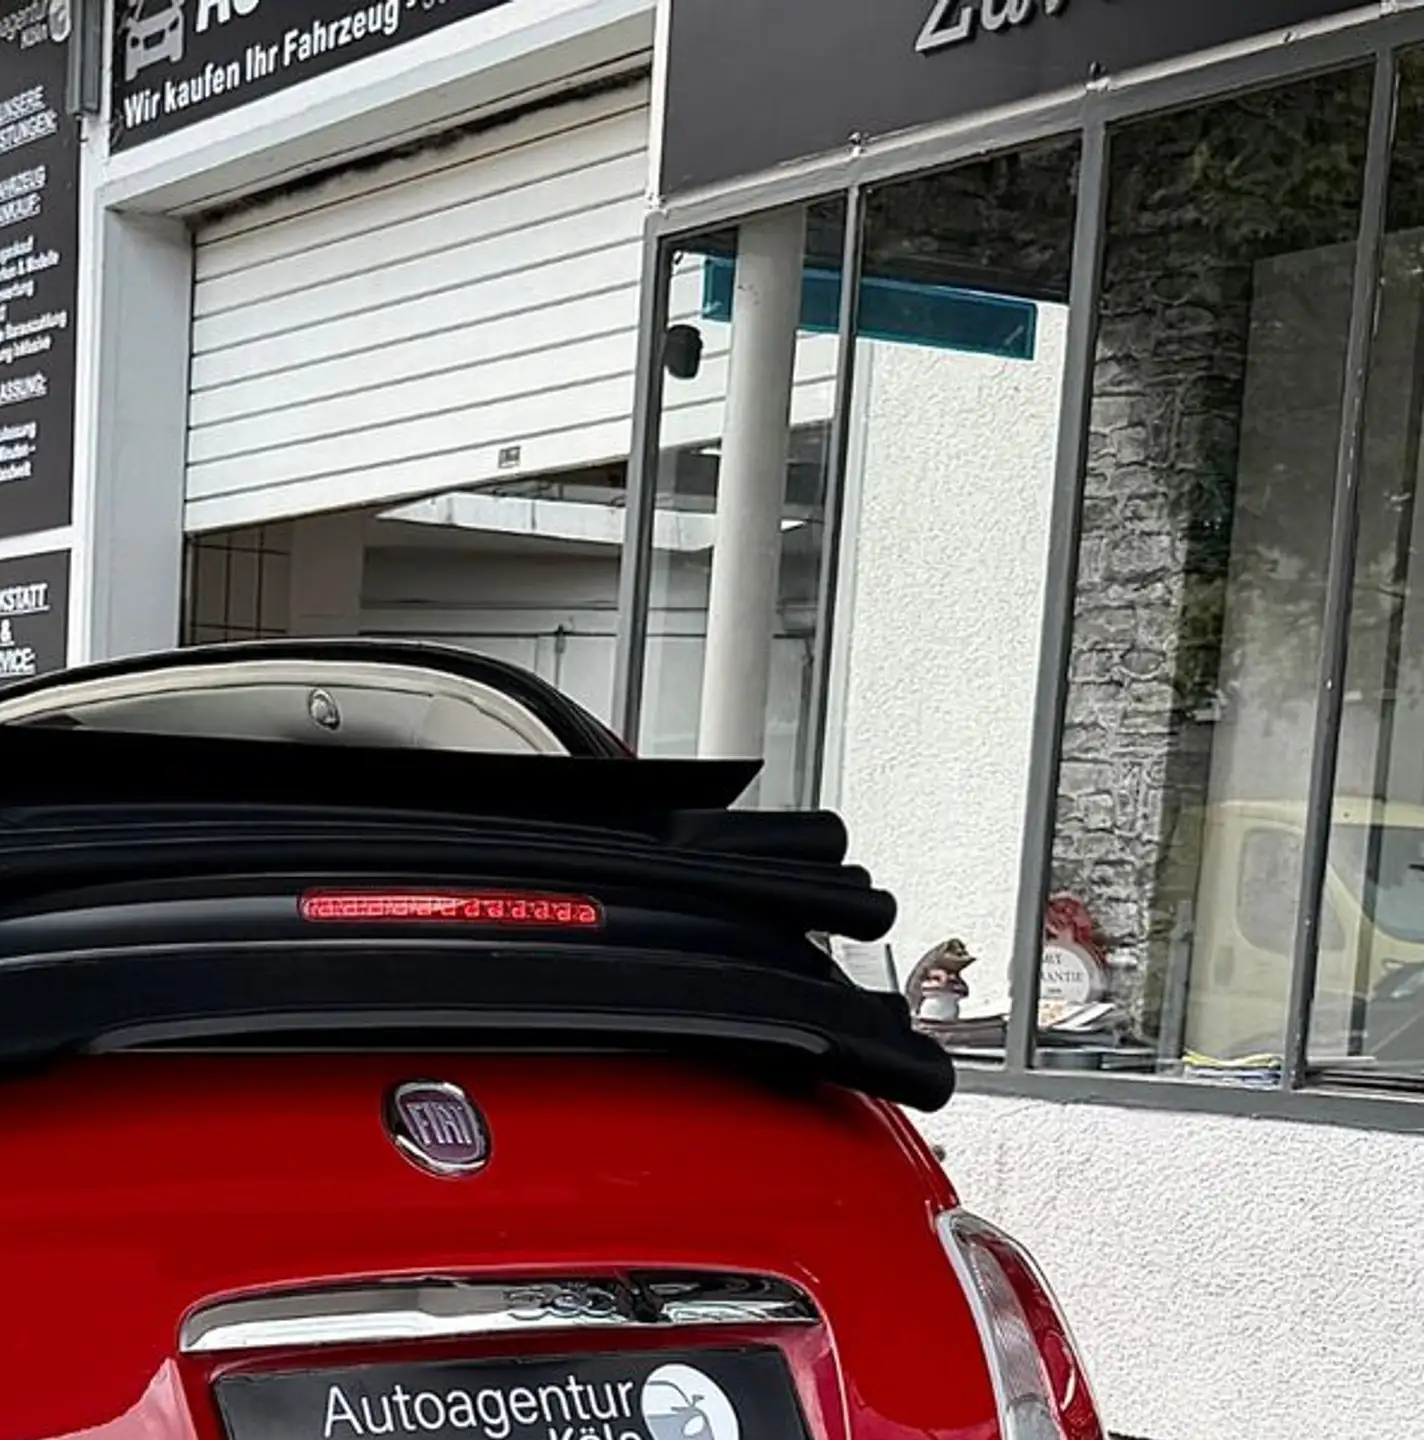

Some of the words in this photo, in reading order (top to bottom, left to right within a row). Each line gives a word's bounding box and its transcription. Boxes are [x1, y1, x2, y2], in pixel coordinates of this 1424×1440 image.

[123, 93, 160, 129] Wir
[164, 59, 239, 113] kaufen
[245, 39, 278, 82] Ihr
[282, 3, 400, 67] Fahrzeug
[0, 619, 15, 646] &
[406, 1101, 473, 1145] FIAT
[323, 1376, 634, 1440] Autoagentur
